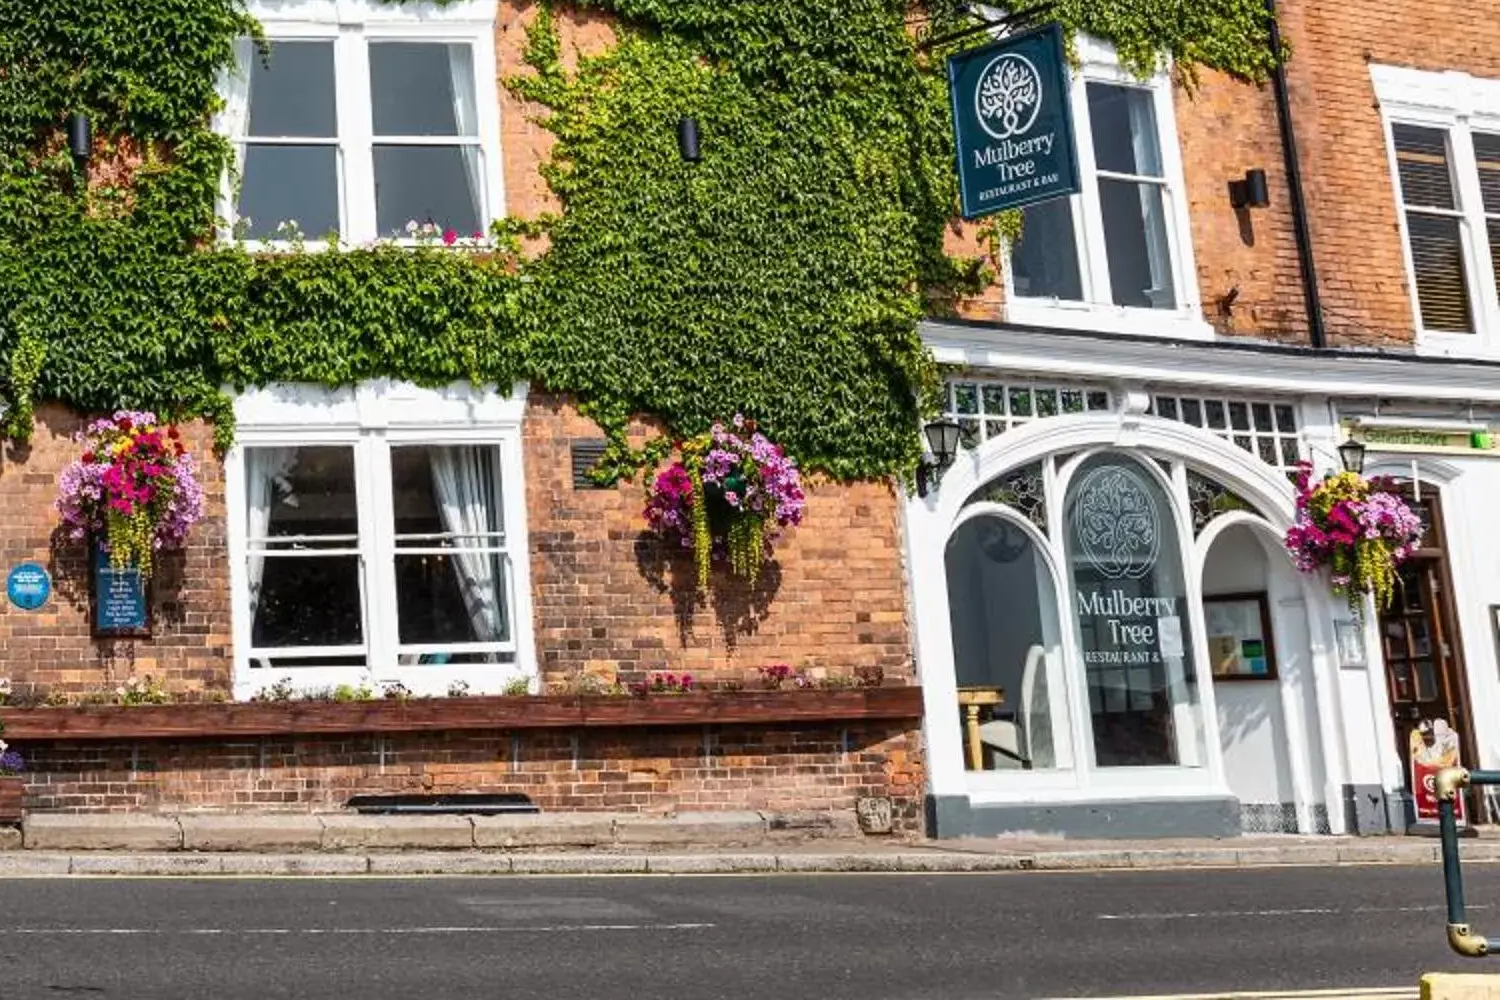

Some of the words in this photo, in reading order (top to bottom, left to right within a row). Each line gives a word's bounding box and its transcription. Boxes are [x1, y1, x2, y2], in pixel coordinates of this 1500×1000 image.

[974, 132, 1055, 169] Mulberry
[997, 160, 1036, 182] Tree
[979, 180, 1032, 200] RESTAURANT
[1077, 589, 1176, 617] Mulberry
[1107, 619, 1156, 645] Tree
[1084, 651, 1150, 663] RESTAURANT
[1151, 651, 1160, 662] &
